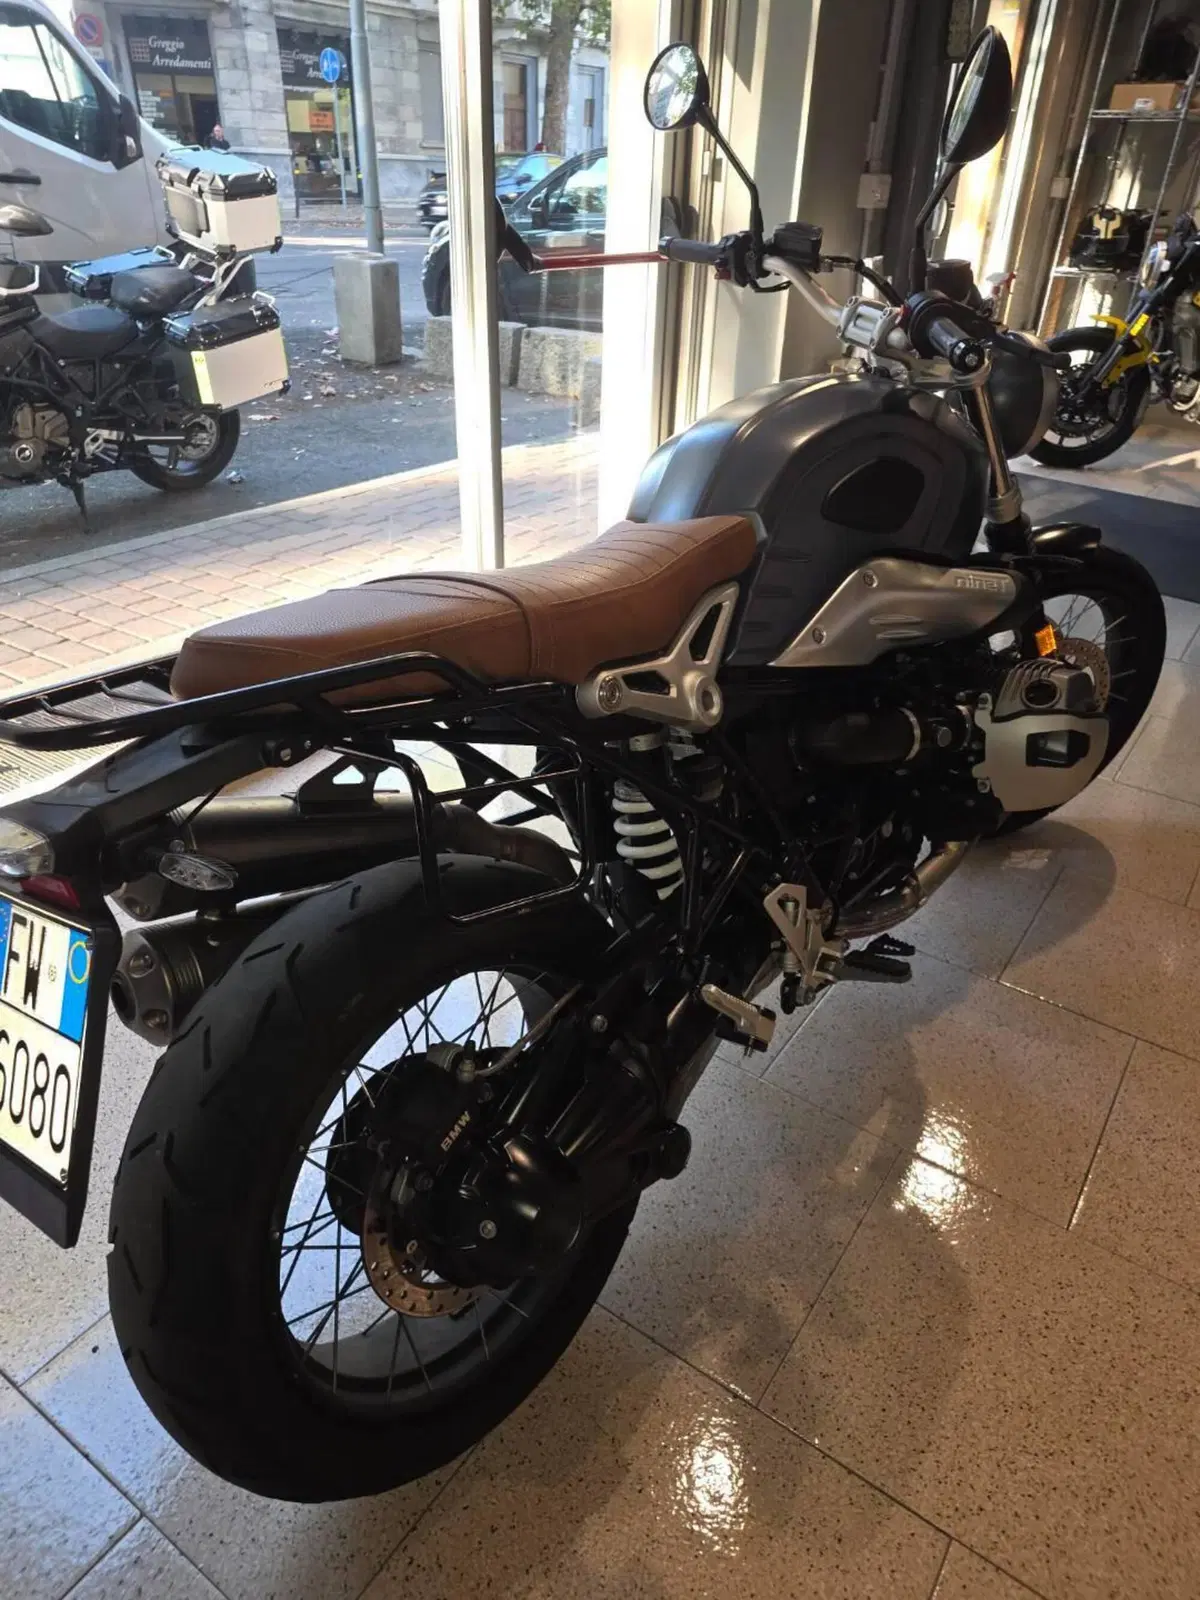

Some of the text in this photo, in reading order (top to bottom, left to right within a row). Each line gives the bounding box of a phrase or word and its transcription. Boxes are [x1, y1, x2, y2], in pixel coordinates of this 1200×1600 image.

[148, 36, 185, 53] Greggio
[152, 54, 212, 69] Arredamenti
[4, 912, 46, 1010] FW
[440, 1110, 471, 1152] BMW
